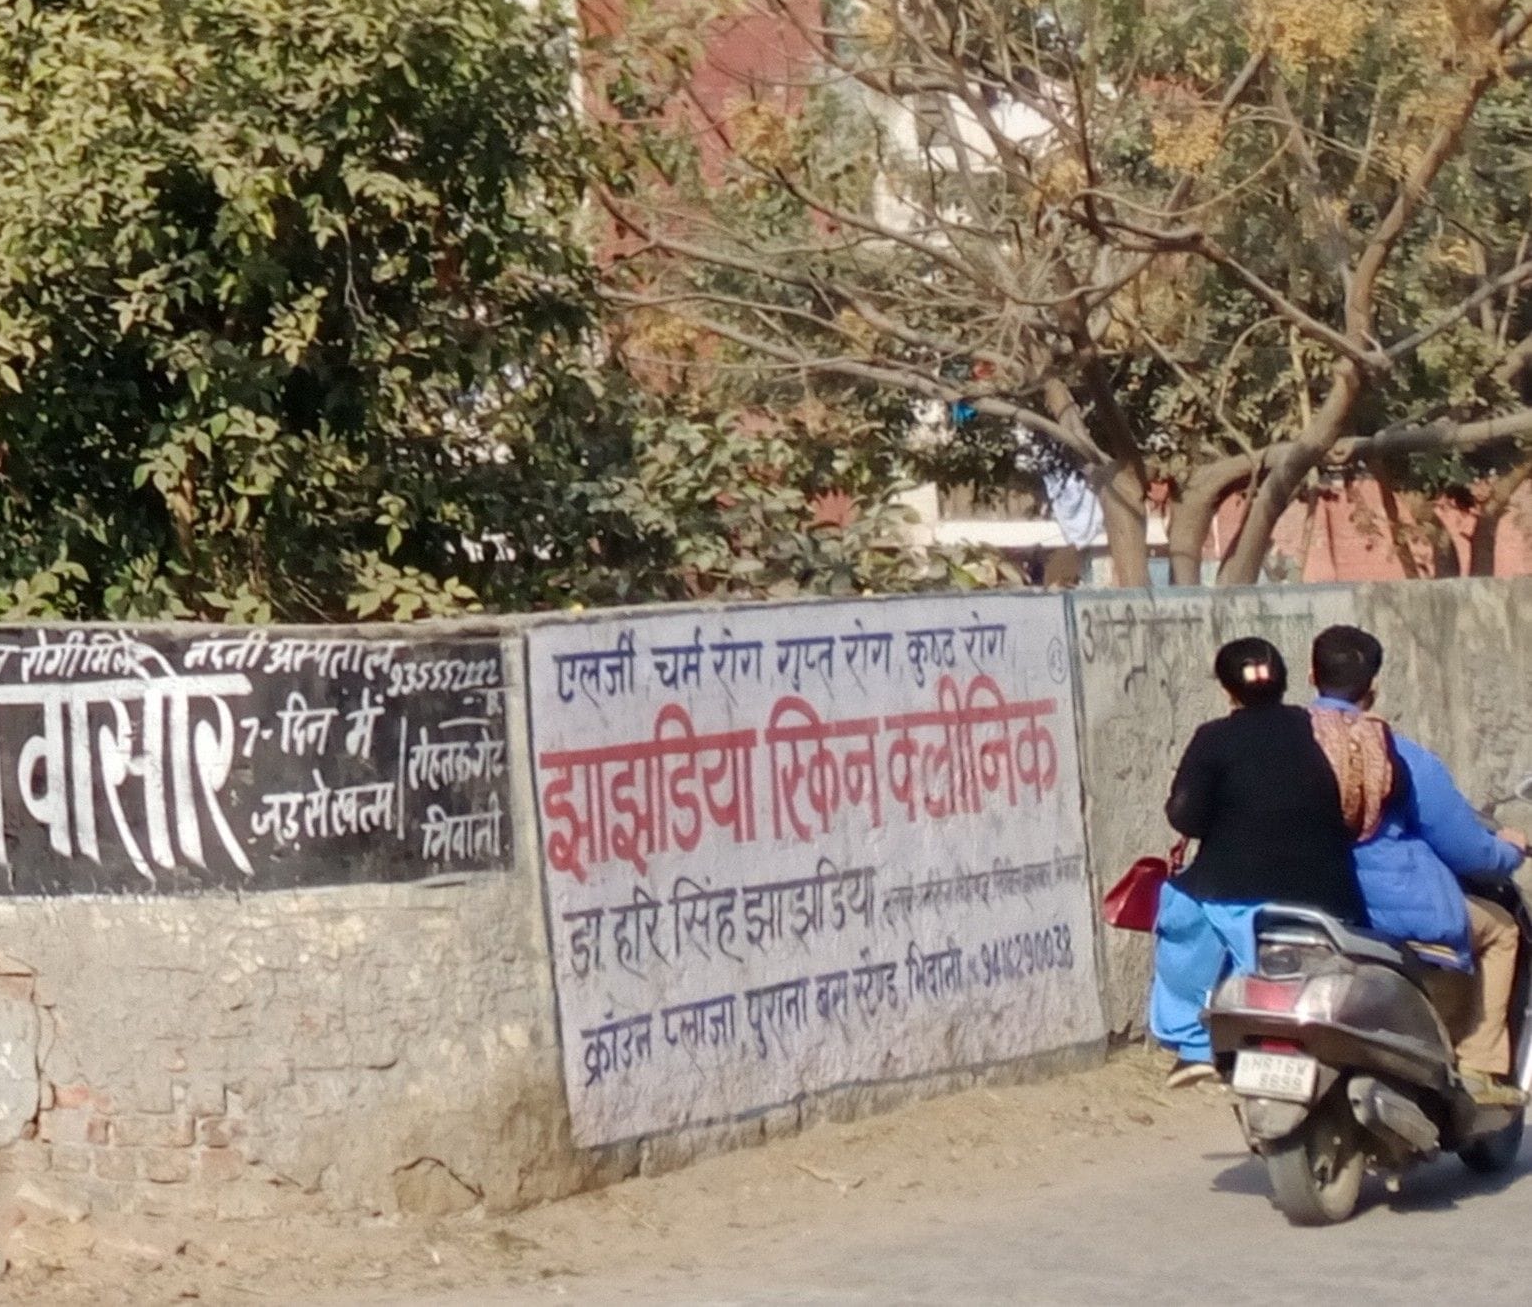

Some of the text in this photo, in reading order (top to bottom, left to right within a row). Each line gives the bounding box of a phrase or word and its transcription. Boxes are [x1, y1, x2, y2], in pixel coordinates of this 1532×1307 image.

[651, 625, 704, 690] चर्म
[709, 627, 763, 694] रोग
[840, 618, 894, 684] रोग
[958, 611, 1007, 672] रोग
[764, 696, 880, 843] स्किन
